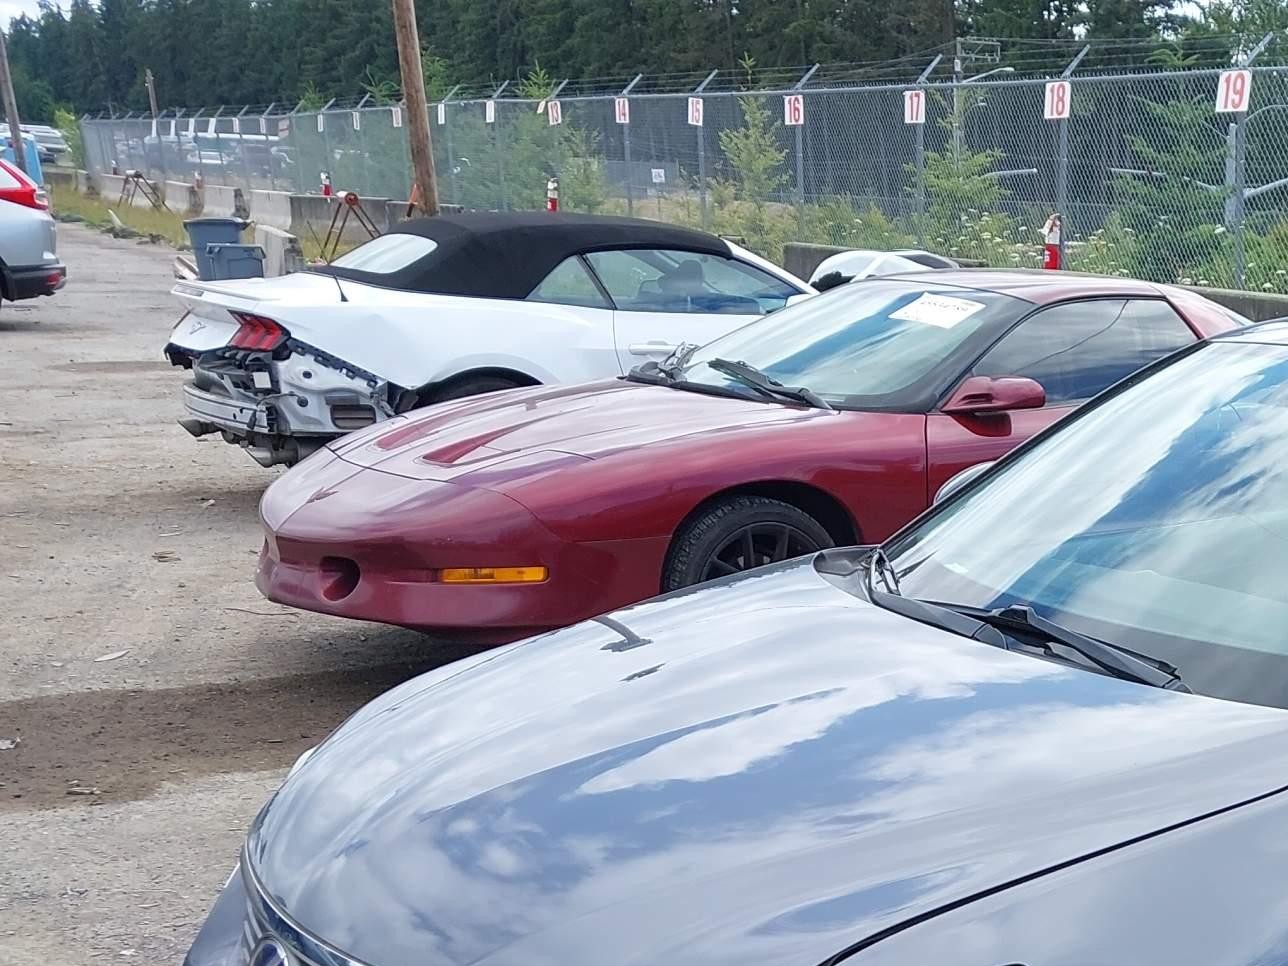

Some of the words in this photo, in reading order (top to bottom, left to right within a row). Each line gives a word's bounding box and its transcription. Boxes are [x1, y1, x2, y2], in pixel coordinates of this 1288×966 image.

[1049, 82, 1067, 117] 18
[1222, 71, 1247, 111] 19
[617, 99, 629, 122] 14
[690, 99, 701, 124] 15
[787, 97, 801, 123] 16
[908, 91, 922, 121] 17
